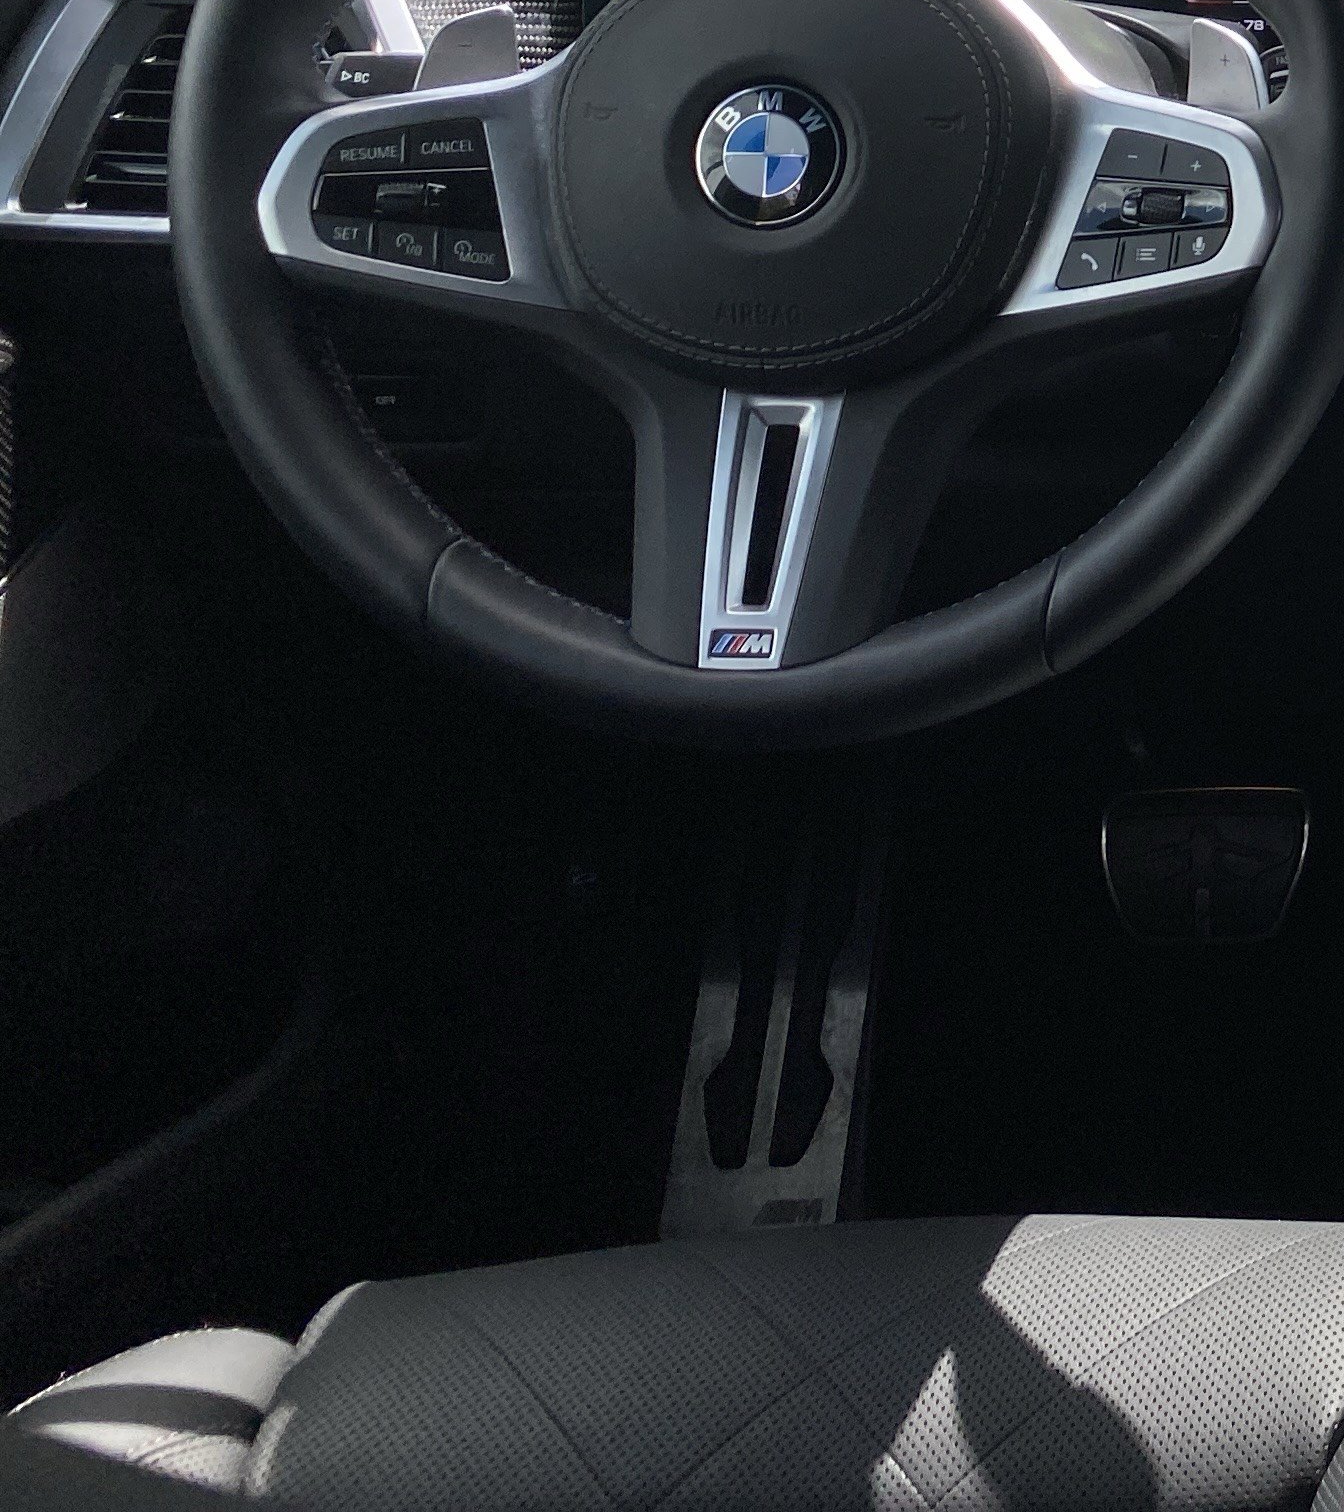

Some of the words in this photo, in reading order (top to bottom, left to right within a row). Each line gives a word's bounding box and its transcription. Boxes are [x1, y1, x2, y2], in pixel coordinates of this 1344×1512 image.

[354, 72, 370, 84] BC
[714, 88, 828, 134] BMW
[339, 144, 398, 162] RESUME
[420, 138, 474, 156] CANCEL
[332, 226, 359, 241] SET
[459, 251, 496, 265] MODE
